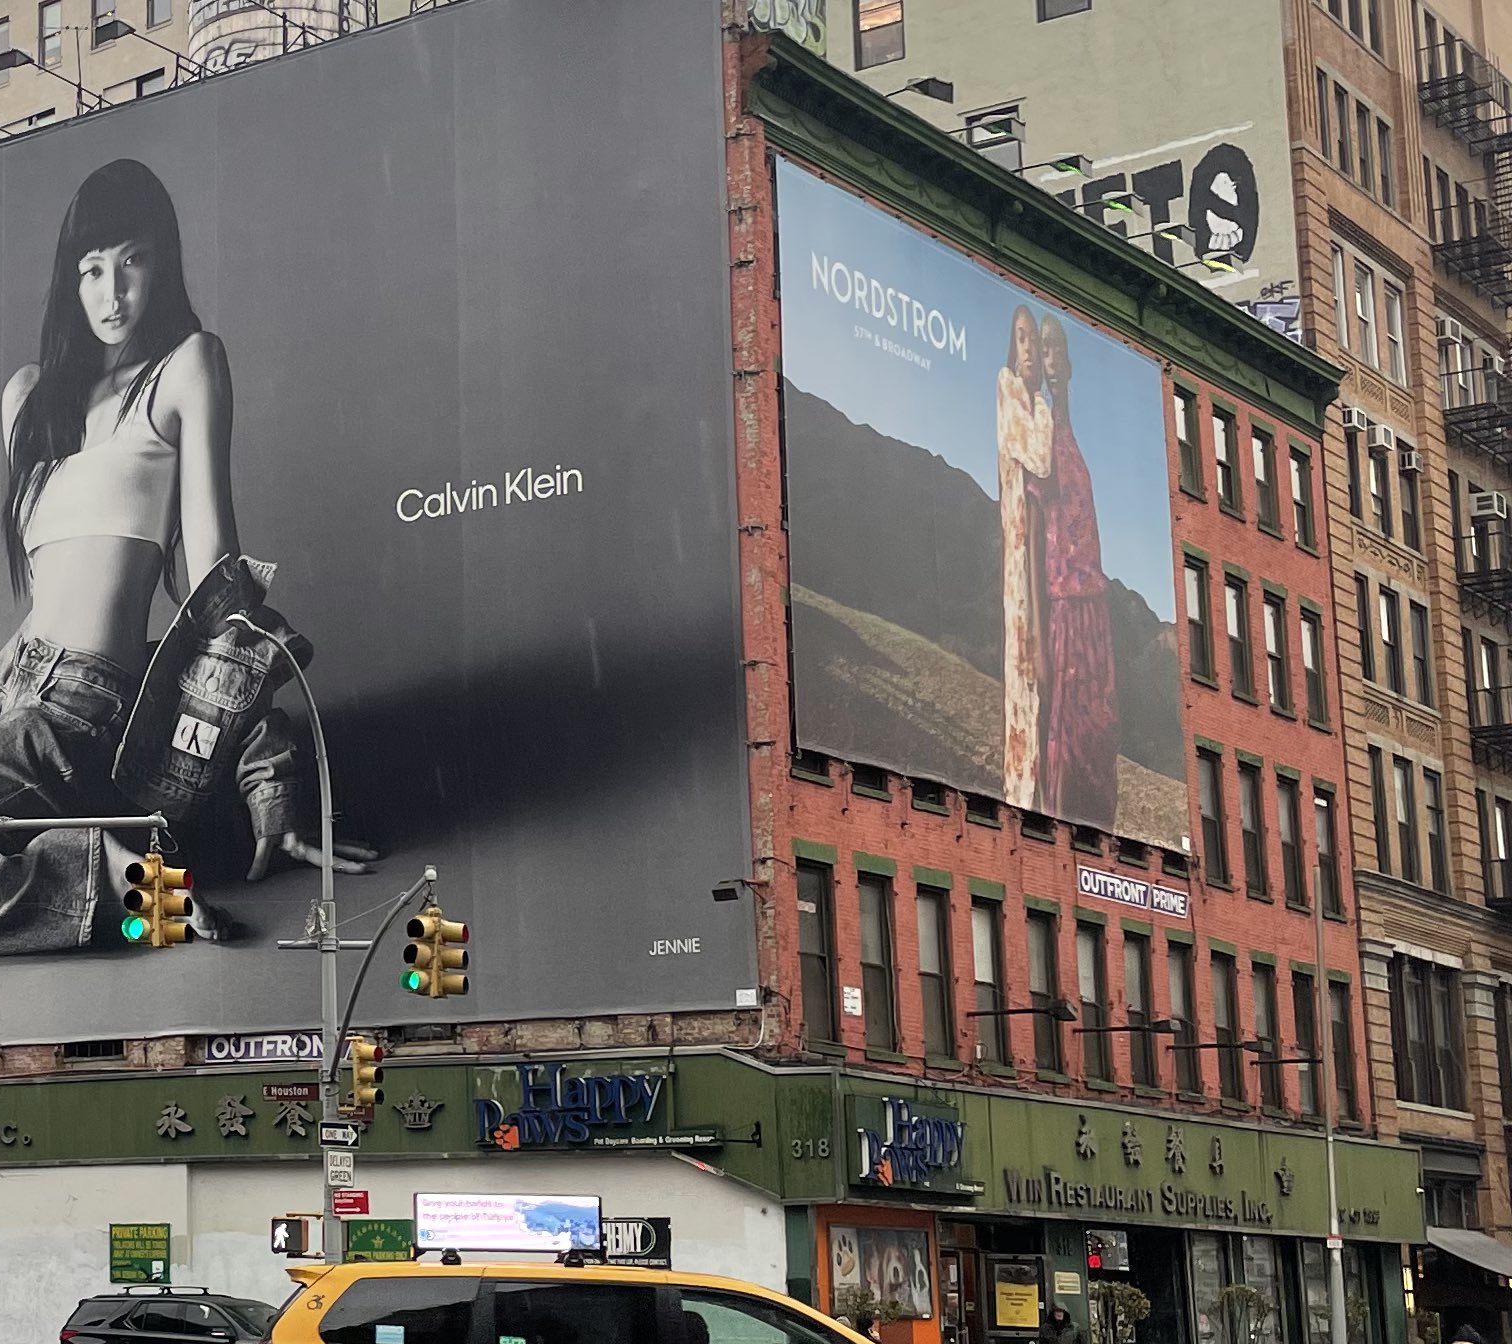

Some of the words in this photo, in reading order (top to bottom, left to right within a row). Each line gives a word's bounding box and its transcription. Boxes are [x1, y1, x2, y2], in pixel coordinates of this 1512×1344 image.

[811, 249, 966, 361] NORDSTROM
[874, 334, 881, 347] &
[882, 338, 932, 371] BROADWAY
[396, 480, 497, 522] Calvin
[505, 464, 583, 504] Klein
[1081, 870, 1147, 905] OUTFRONT
[1152, 889, 1186, 915] PRIME
[649, 937, 701, 956] JENNIE
[211, 1033, 323, 1058] OUTFRON
[271, 1086, 308, 1096] Houston
[516, 1063, 666, 1125] Happy
[324, 1130, 337, 1140] ONE
[342, 1130, 354, 1140] WAY
[473, 1099, 590, 1145] Paws
[882, 1096, 967, 1168] Happy
[329, 1155, 352, 1167] DELAYED
[792, 1138, 830, 1158] 318
[330, 1169, 352, 1182] GREEN
[1044, 1165, 1154, 1213] RESTAURANT
[112, 1226, 138, 1239] PRIVATE
[139, 1226, 168, 1239] PARKING
